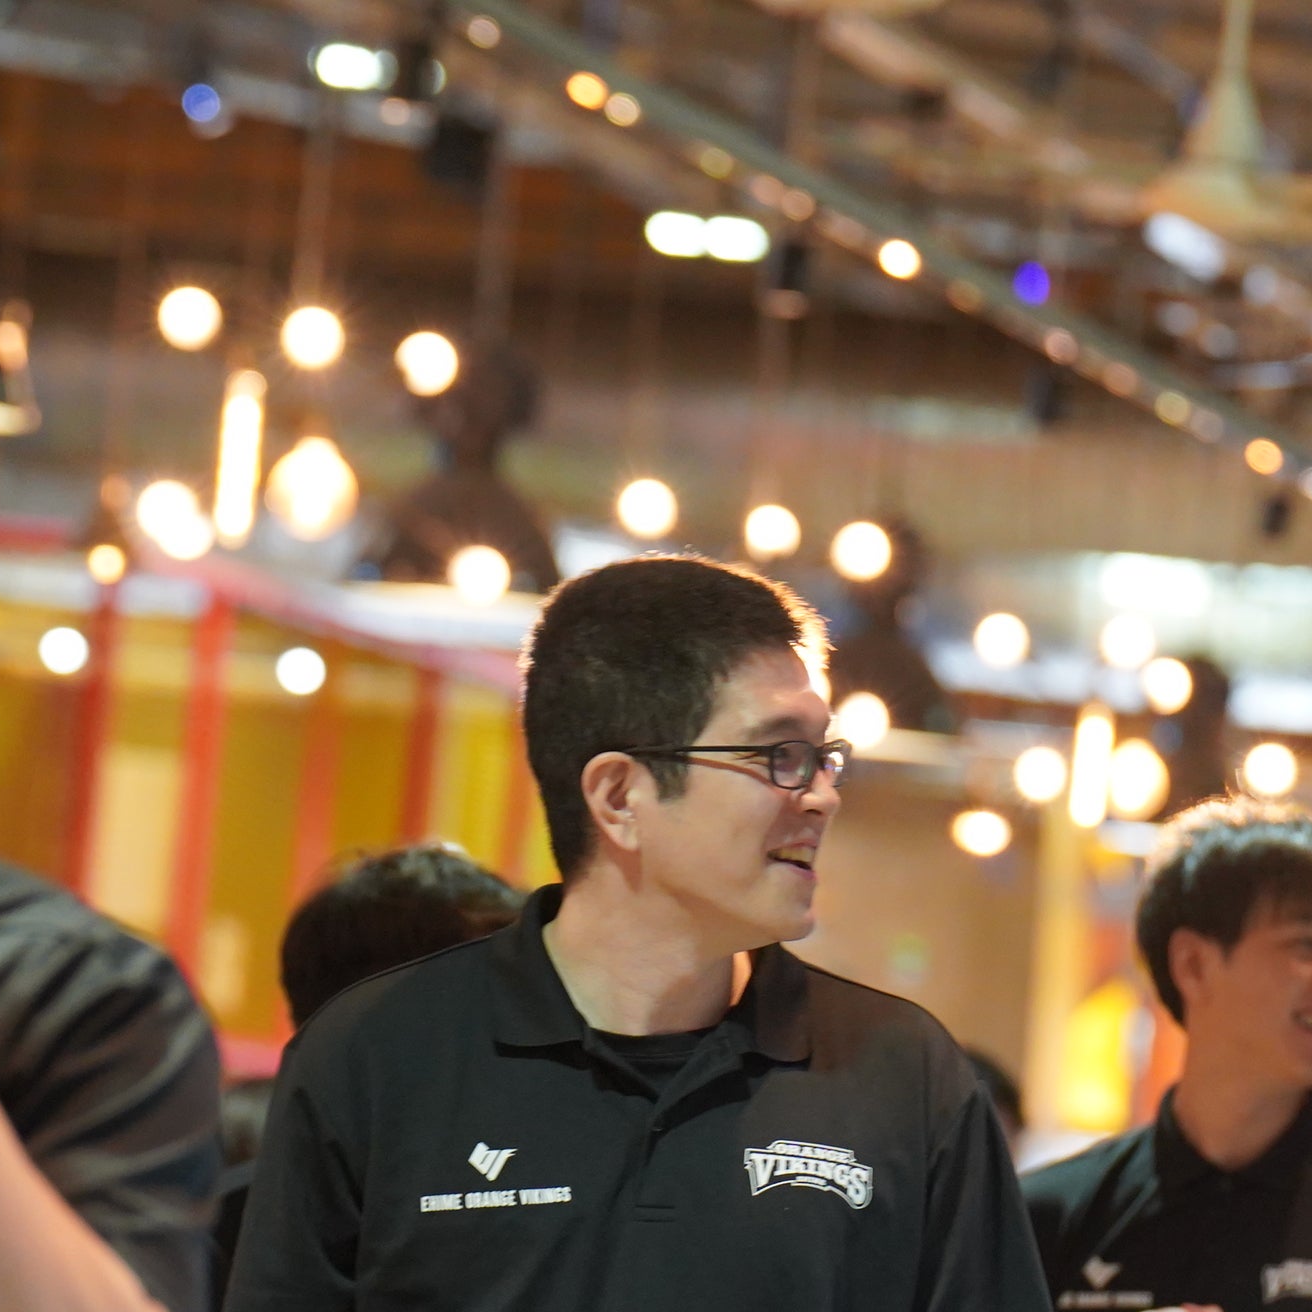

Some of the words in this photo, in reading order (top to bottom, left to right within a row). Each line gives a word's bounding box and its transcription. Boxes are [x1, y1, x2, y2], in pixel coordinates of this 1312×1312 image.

[465, 1190, 518, 1209] ORANGE
[519, 1186, 572, 1205] VIKINGS
[747, 1152, 871, 1206] VIKINGS
